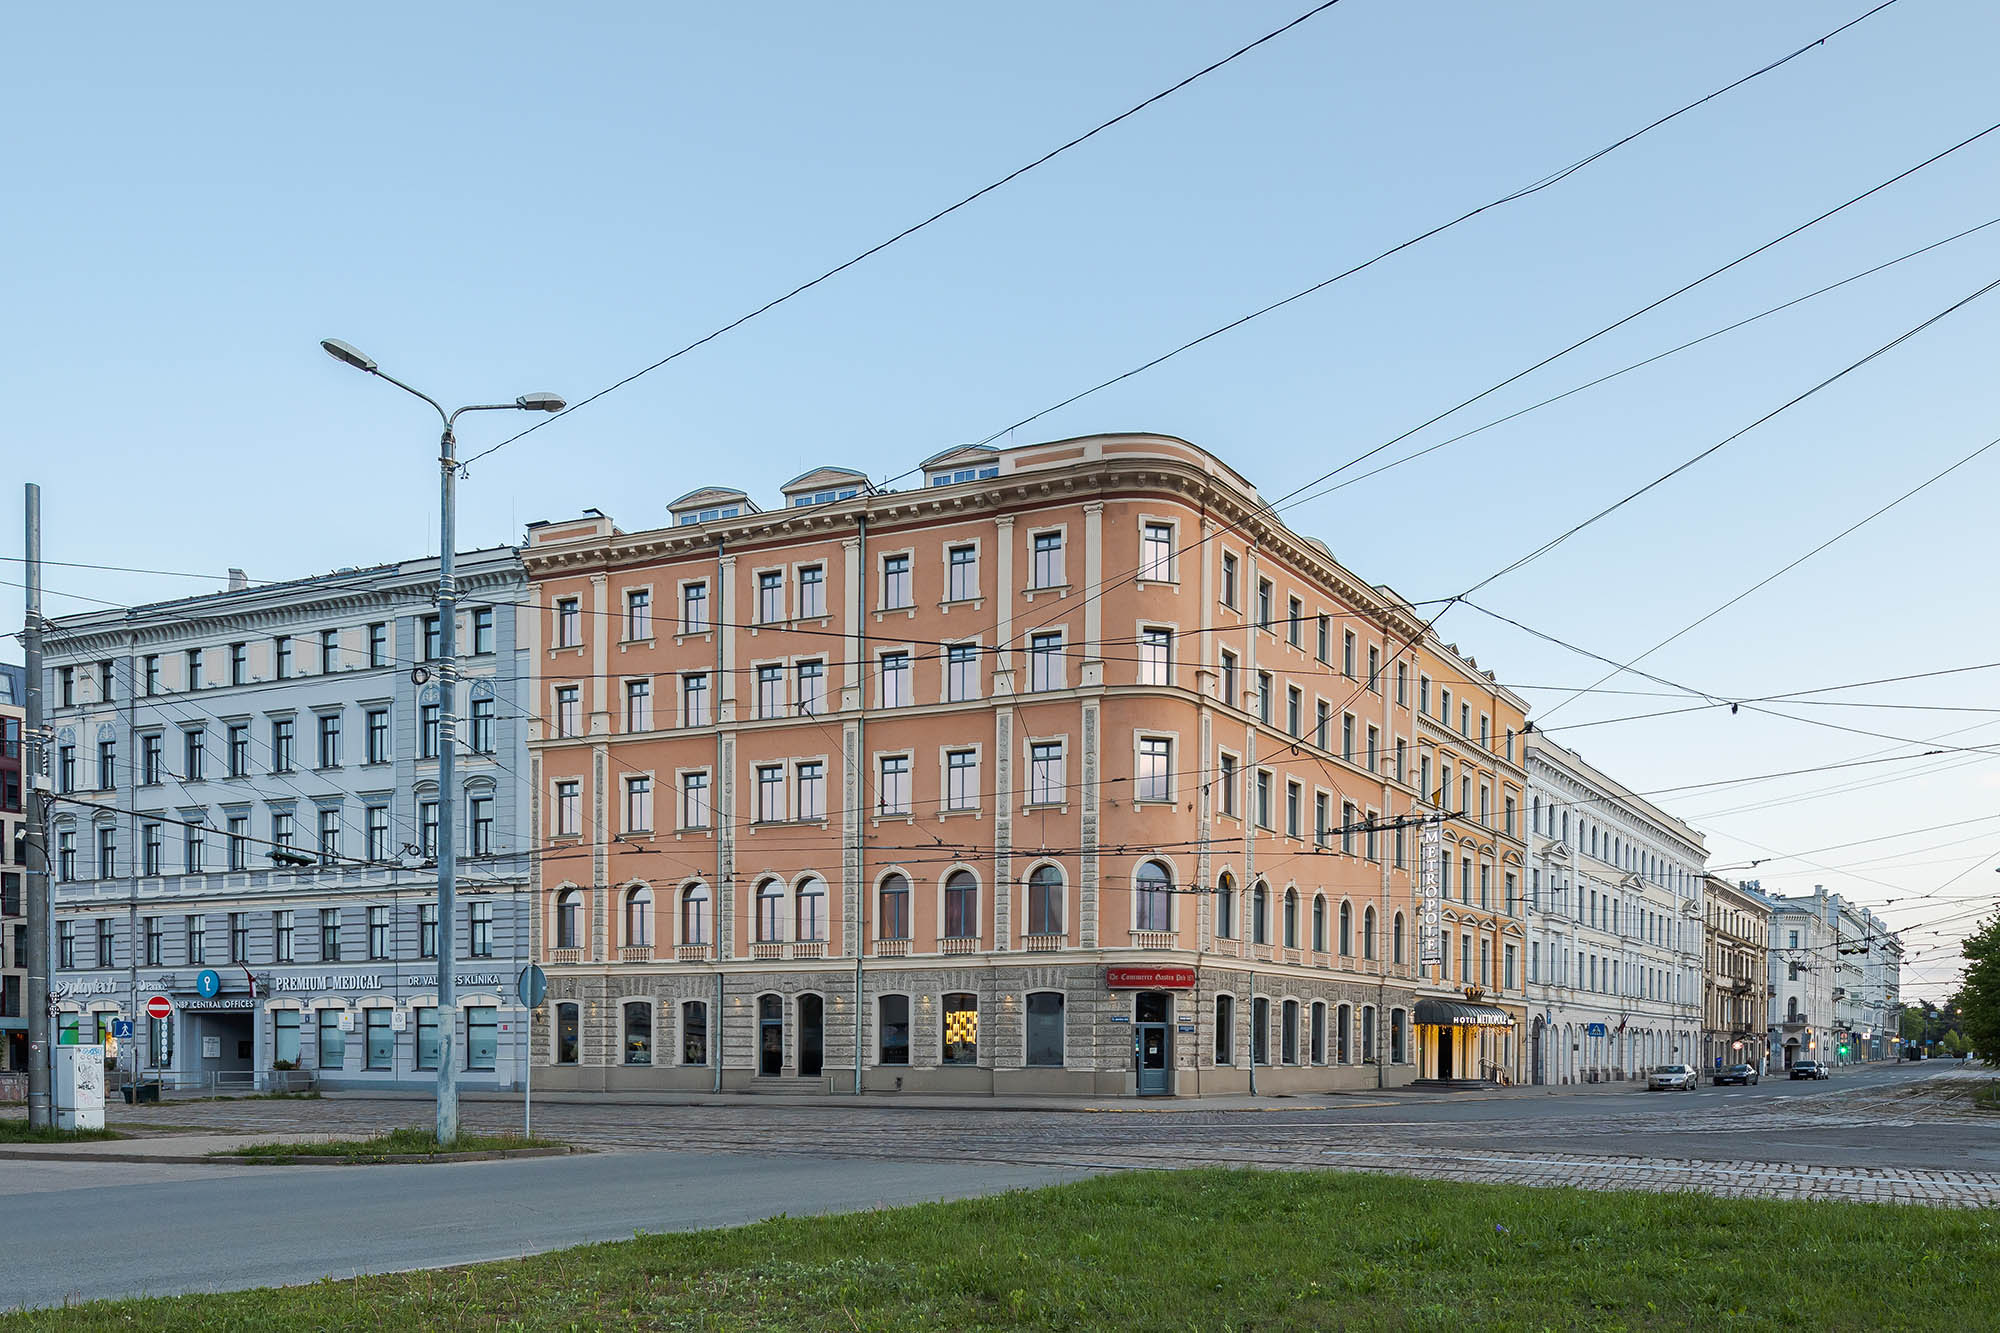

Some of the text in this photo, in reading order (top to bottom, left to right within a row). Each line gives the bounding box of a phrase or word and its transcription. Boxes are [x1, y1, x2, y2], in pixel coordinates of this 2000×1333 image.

[1425, 831, 1438, 951] METROPOLE
[69, 978, 117, 997] playtech
[276, 975, 382, 991] PREMIUM MEDICAL
[192, 1001, 221, 1009] CENTRAL
[224, 1000, 254, 1008] OFFICES
[1453, 1016, 1476, 1024] HOTEL
